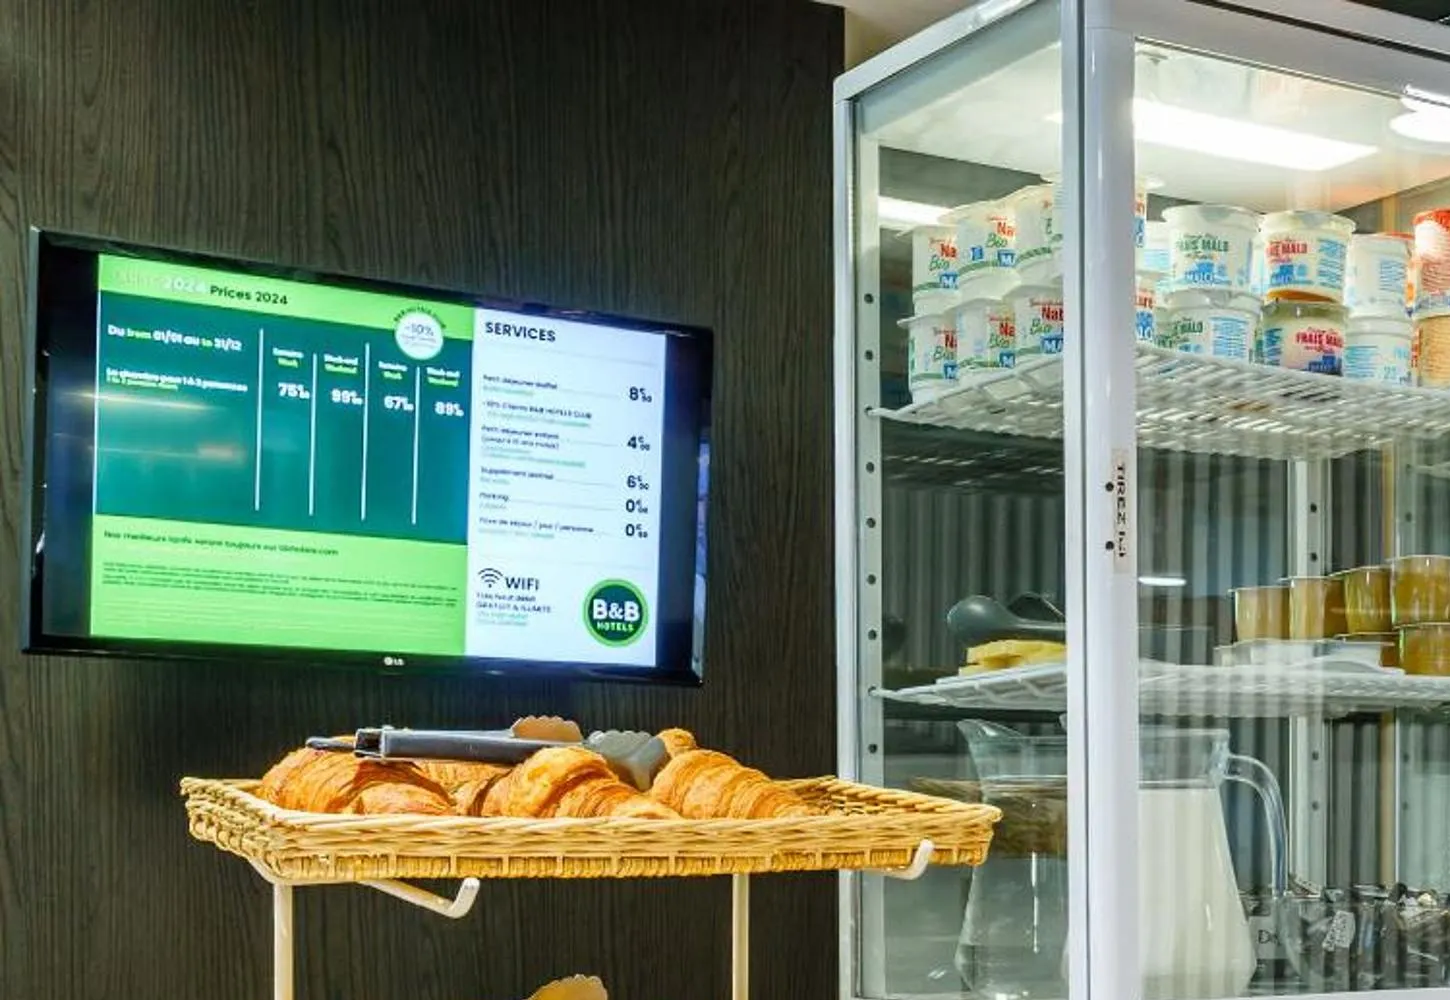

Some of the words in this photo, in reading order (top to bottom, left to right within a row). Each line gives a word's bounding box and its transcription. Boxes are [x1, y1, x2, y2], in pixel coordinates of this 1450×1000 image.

[210, 285, 252, 301] Prices
[254, 290, 288, 305] 2024
[485, 321, 556, 342] SERVICES
[592, 599, 640, 622] B&B
[596, 622, 634, 632] HOTELS
